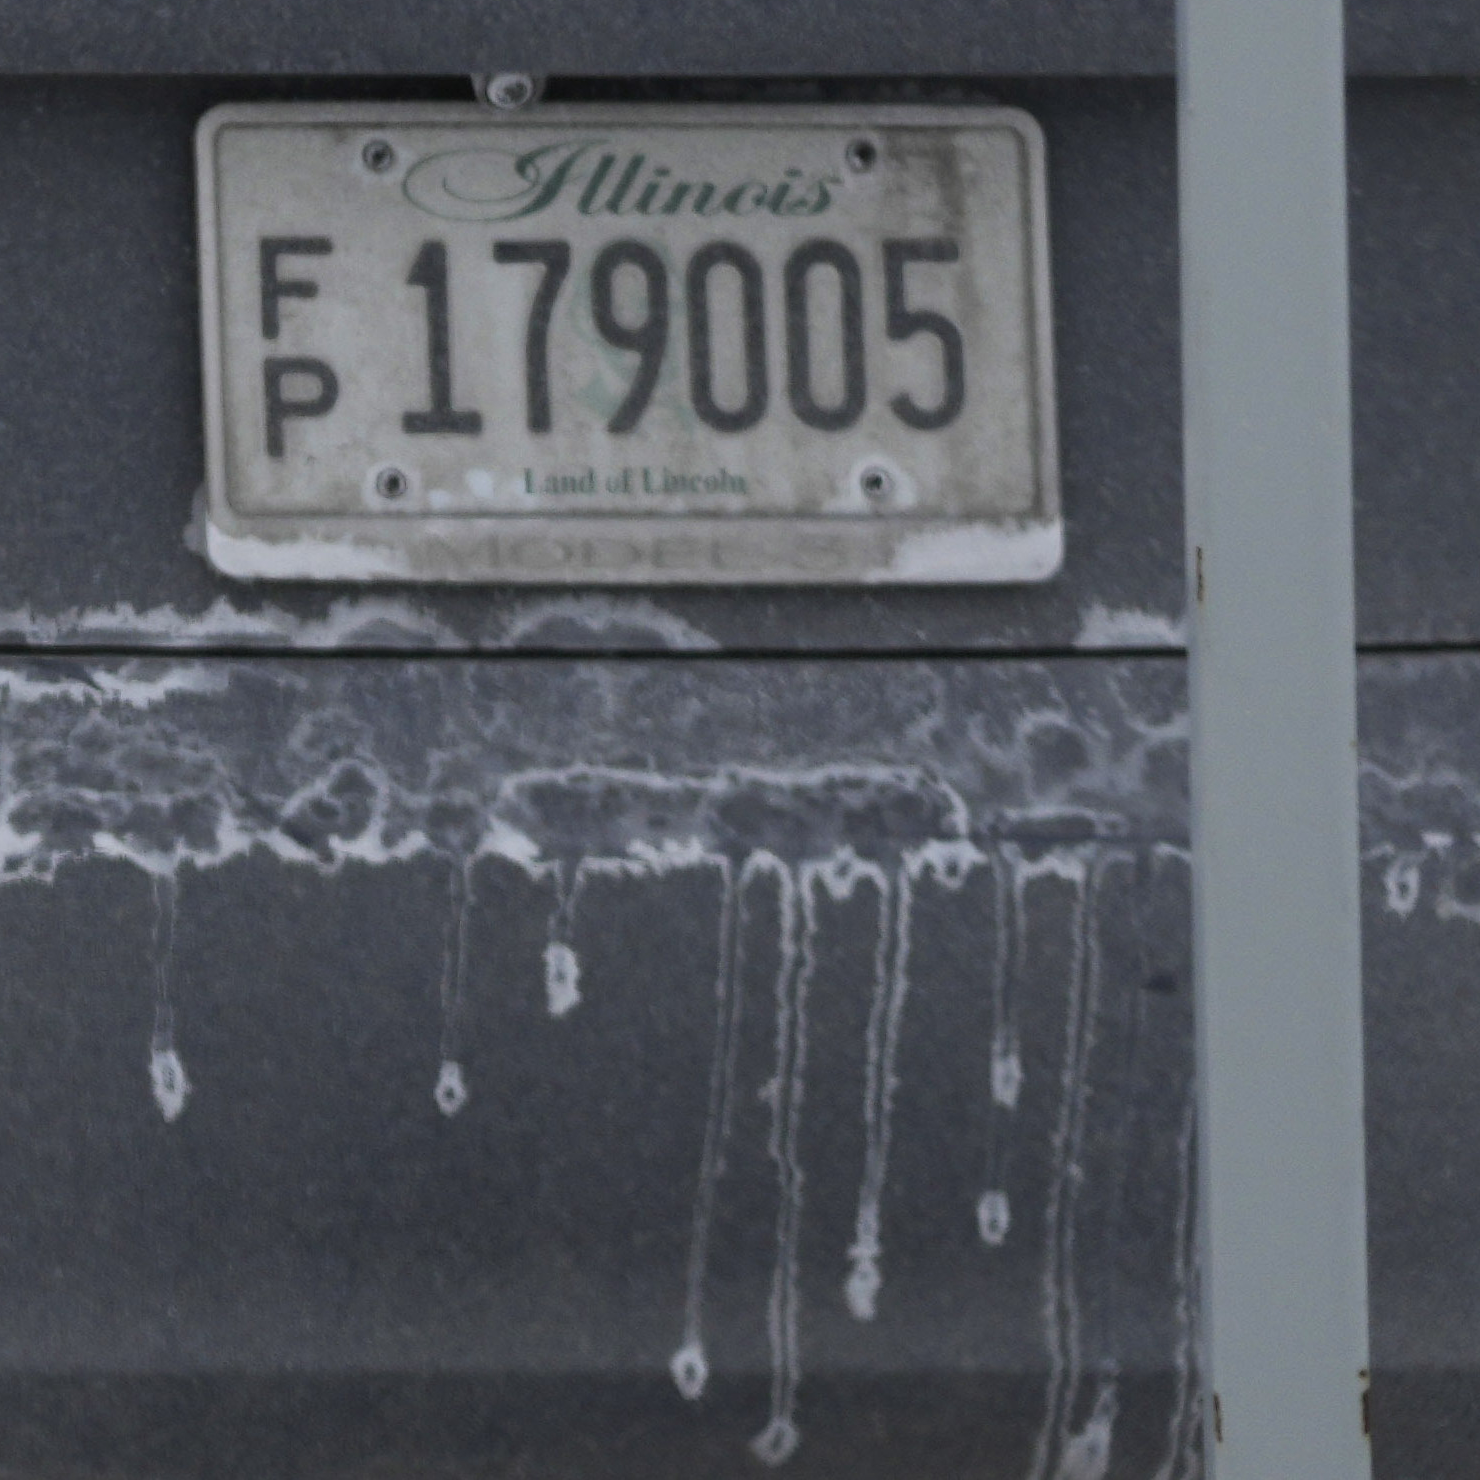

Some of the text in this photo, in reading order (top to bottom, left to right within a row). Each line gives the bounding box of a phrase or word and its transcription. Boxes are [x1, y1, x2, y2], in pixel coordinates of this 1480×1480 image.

[401, 140, 841, 222] Illinois
[403, 238, 965, 434] 179005
[523, 466, 747, 493] Land of Lincoln
